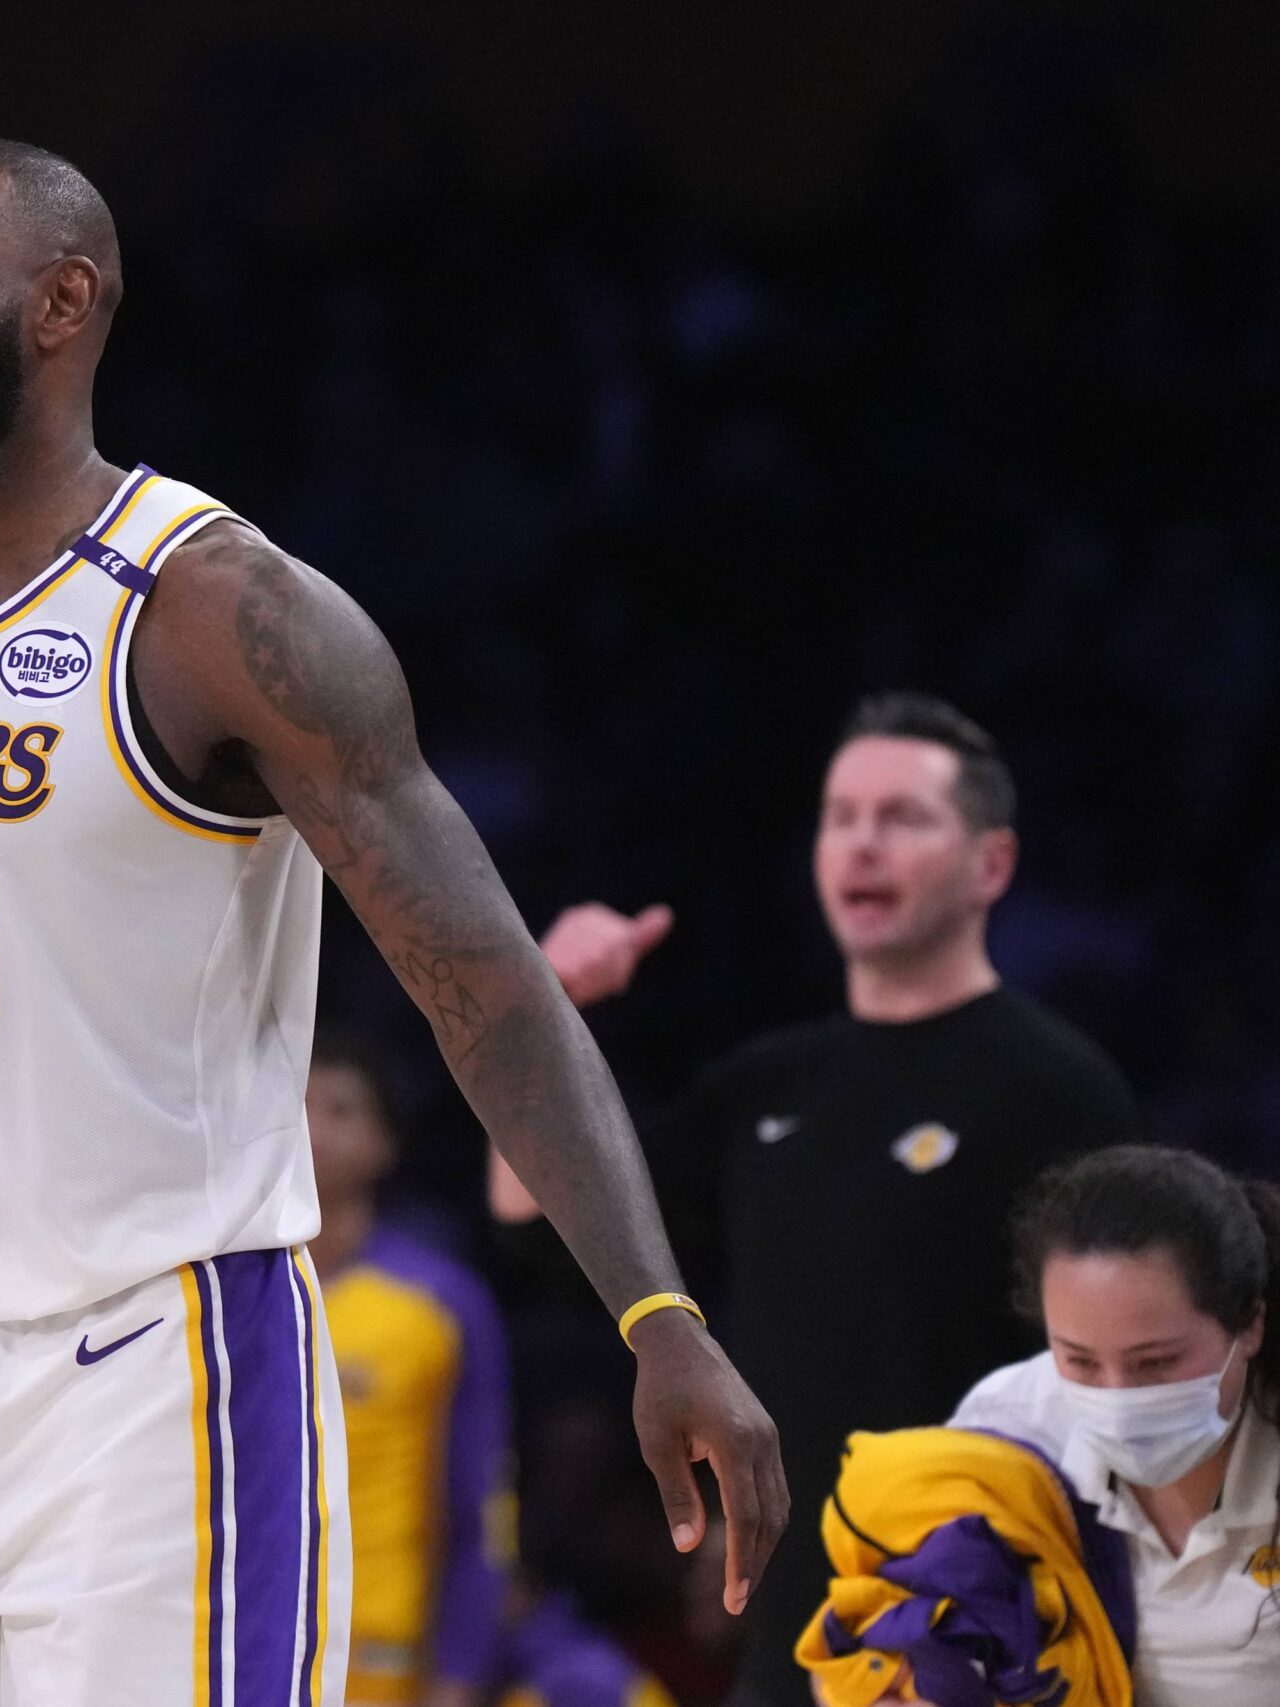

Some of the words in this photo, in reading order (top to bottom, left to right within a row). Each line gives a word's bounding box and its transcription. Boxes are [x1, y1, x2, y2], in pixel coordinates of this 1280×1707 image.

[99, 551, 128, 575] 44
[7, 646, 86, 679] bibigo
[17, 670, 51, 683] 비비고
